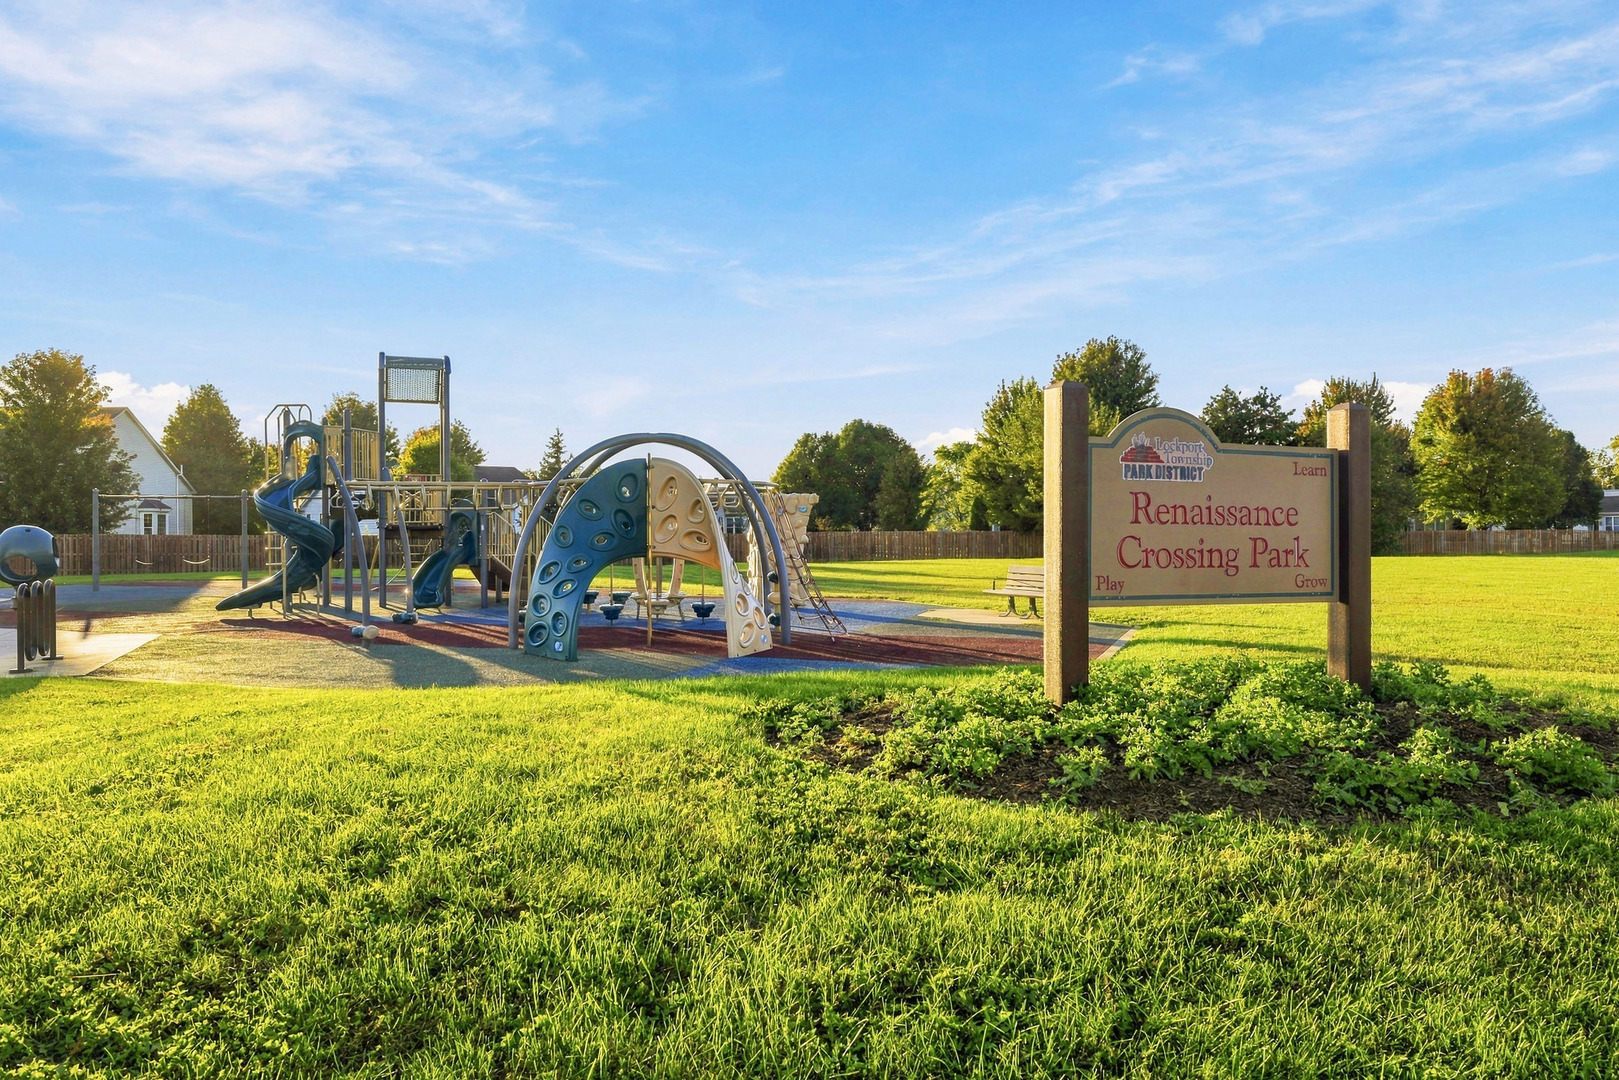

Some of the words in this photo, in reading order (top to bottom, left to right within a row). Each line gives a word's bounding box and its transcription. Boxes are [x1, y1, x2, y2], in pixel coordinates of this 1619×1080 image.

[1155, 438, 1204, 454] Lockport
[1164, 451, 1213, 467] Township
[1124, 463, 1153, 479] PARK
[1155, 464, 1204, 480] DISTRICT
[1292, 461, 1327, 477] Learn
[1130, 491, 1298, 526] Renaissance
[1116, 535, 1240, 577] Crossing
[1249, 535, 1310, 568] Park
[1095, 575, 1125, 594] Play
[1295, 573, 1328, 588] Grow
